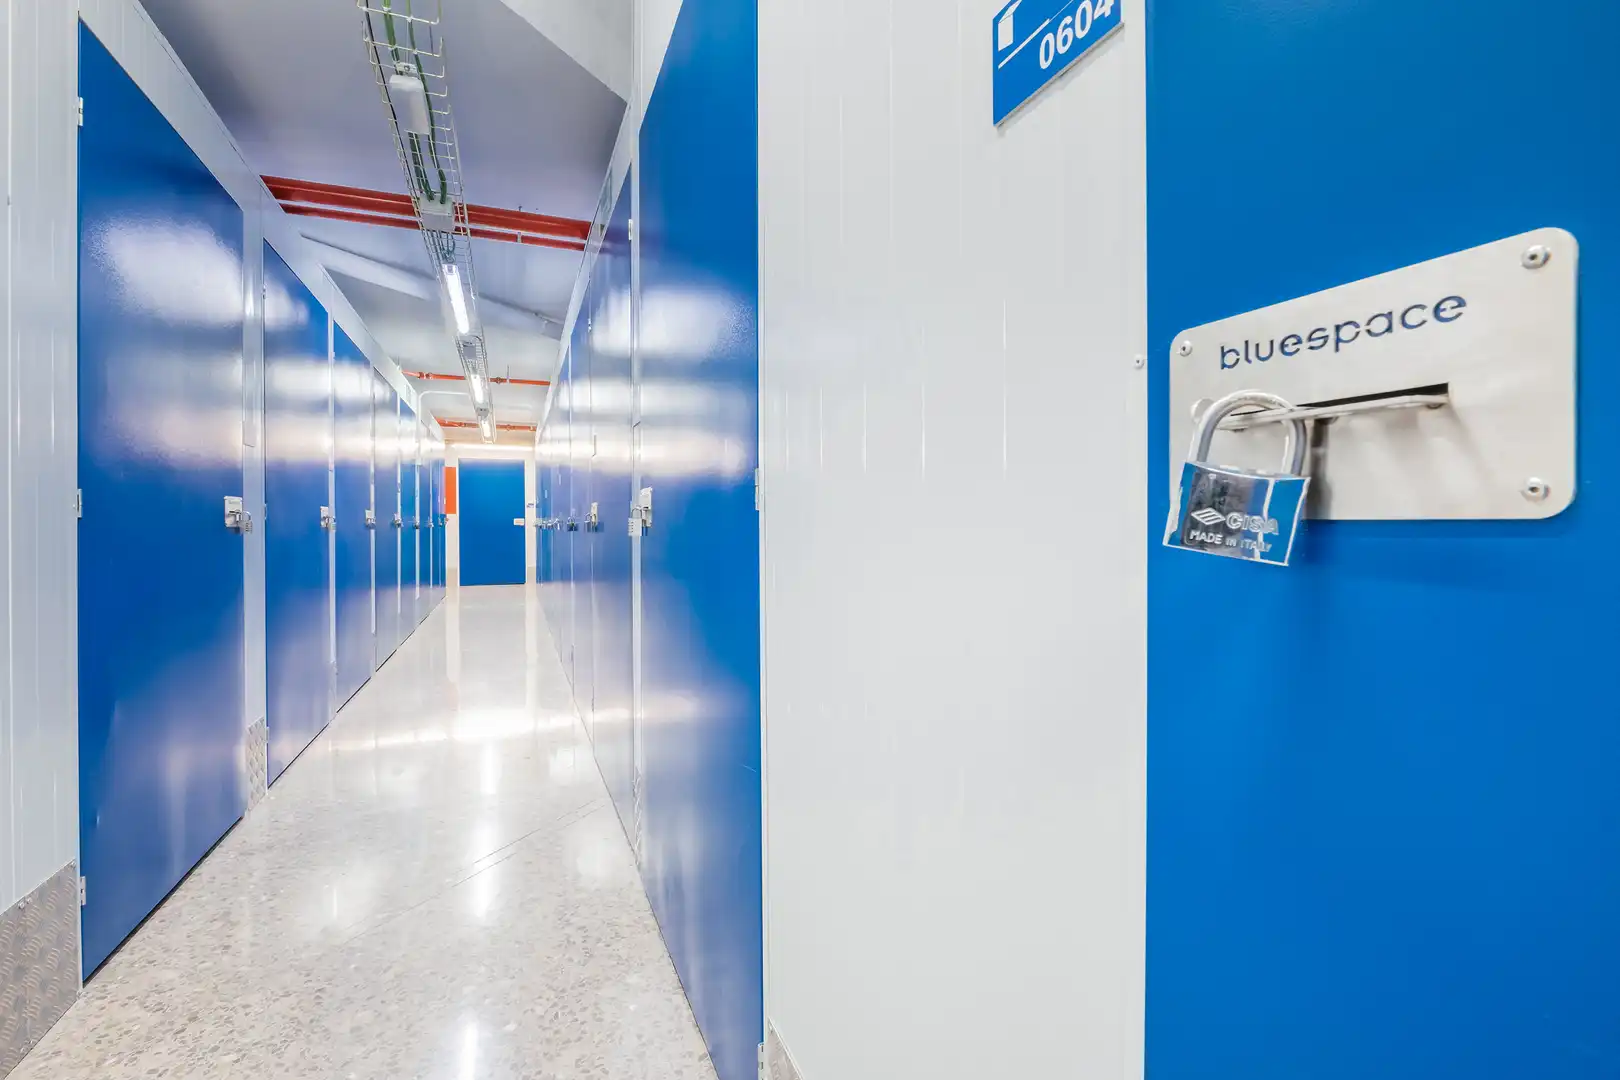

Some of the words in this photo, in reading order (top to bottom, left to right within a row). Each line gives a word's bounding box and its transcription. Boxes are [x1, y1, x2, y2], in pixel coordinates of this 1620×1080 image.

[1220, 295, 1467, 370] bluespace
[1226, 512, 1279, 535] CISA
[1189, 530, 1223, 545] MADE
